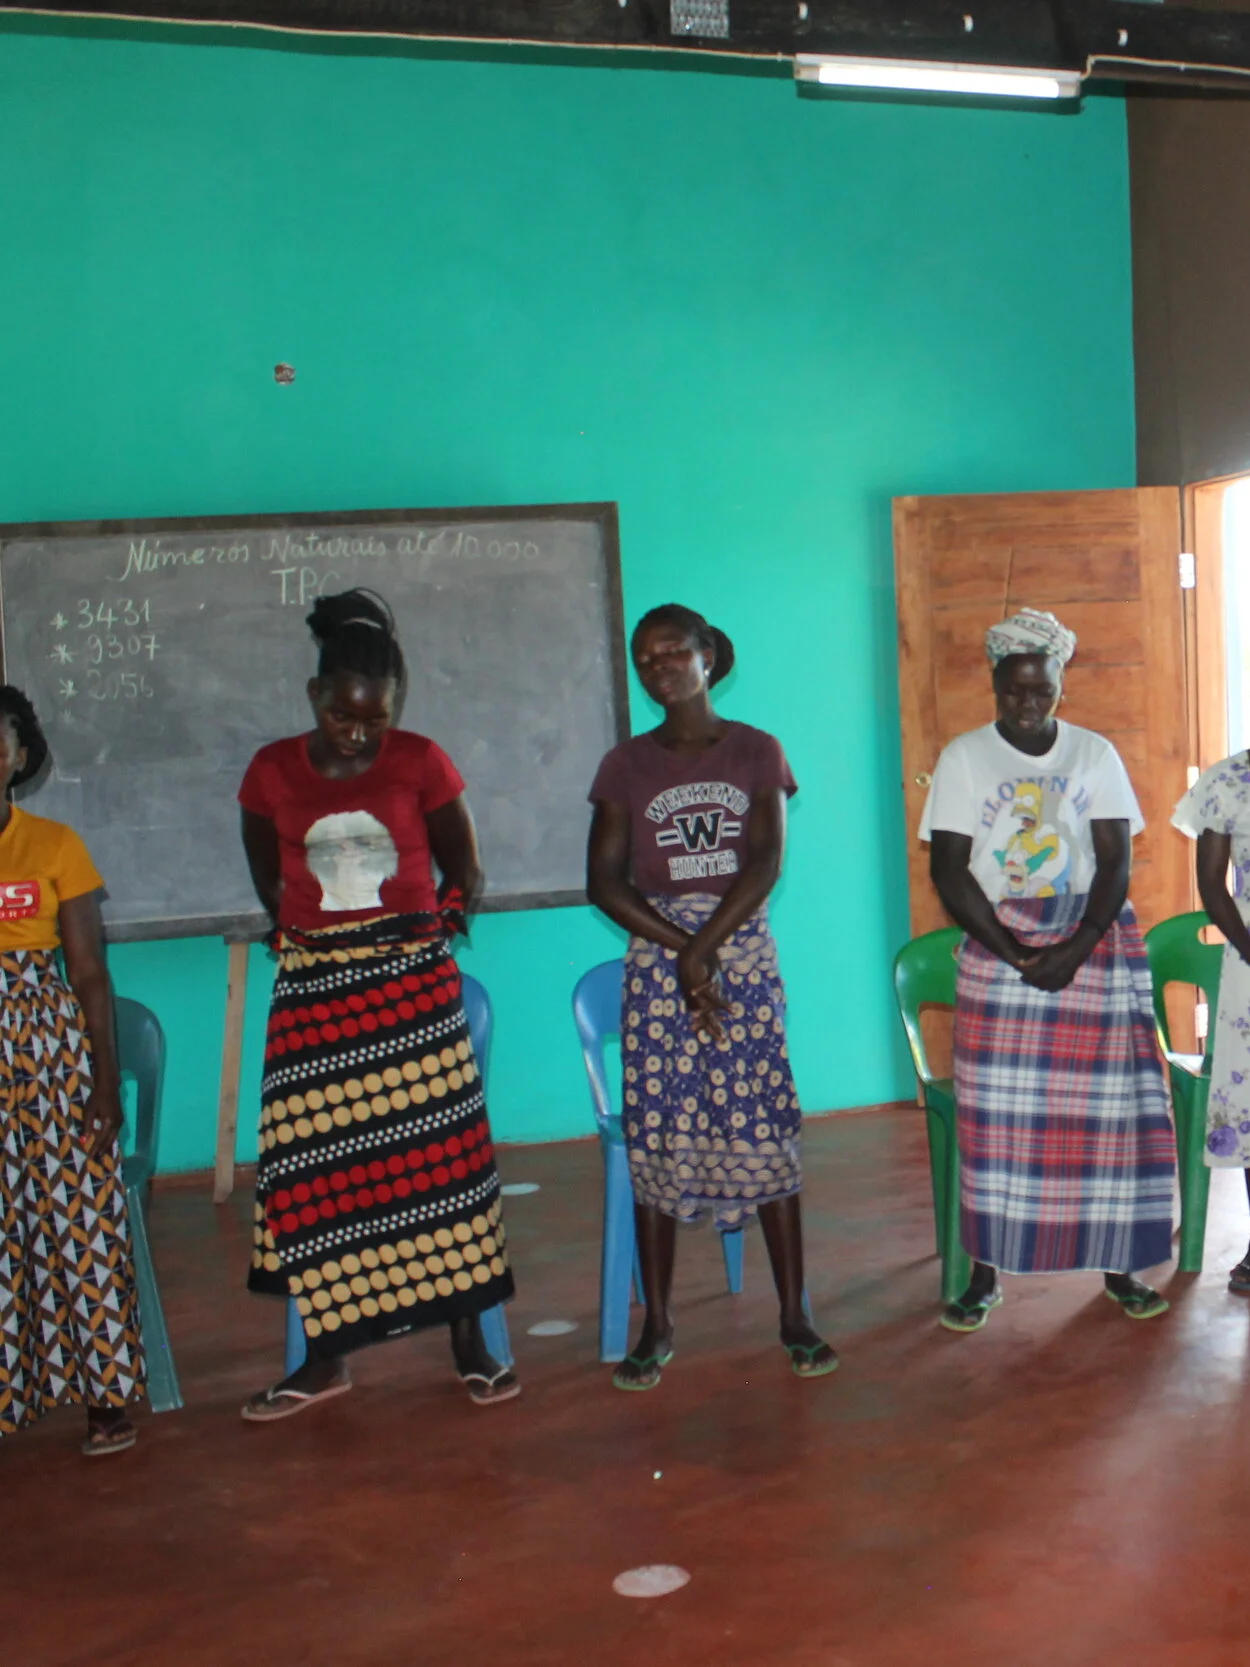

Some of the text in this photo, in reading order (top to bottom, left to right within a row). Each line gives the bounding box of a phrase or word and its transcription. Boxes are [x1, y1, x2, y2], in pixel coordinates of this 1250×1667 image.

[78, 598, 150, 629] 3431
[87, 633, 161, 665] 9307
[644, 781, 750, 824] WEEKEND
[672, 808, 725, 853] W
[668, 848, 739, 881] HUNTER
[0, 884, 34, 908] S
